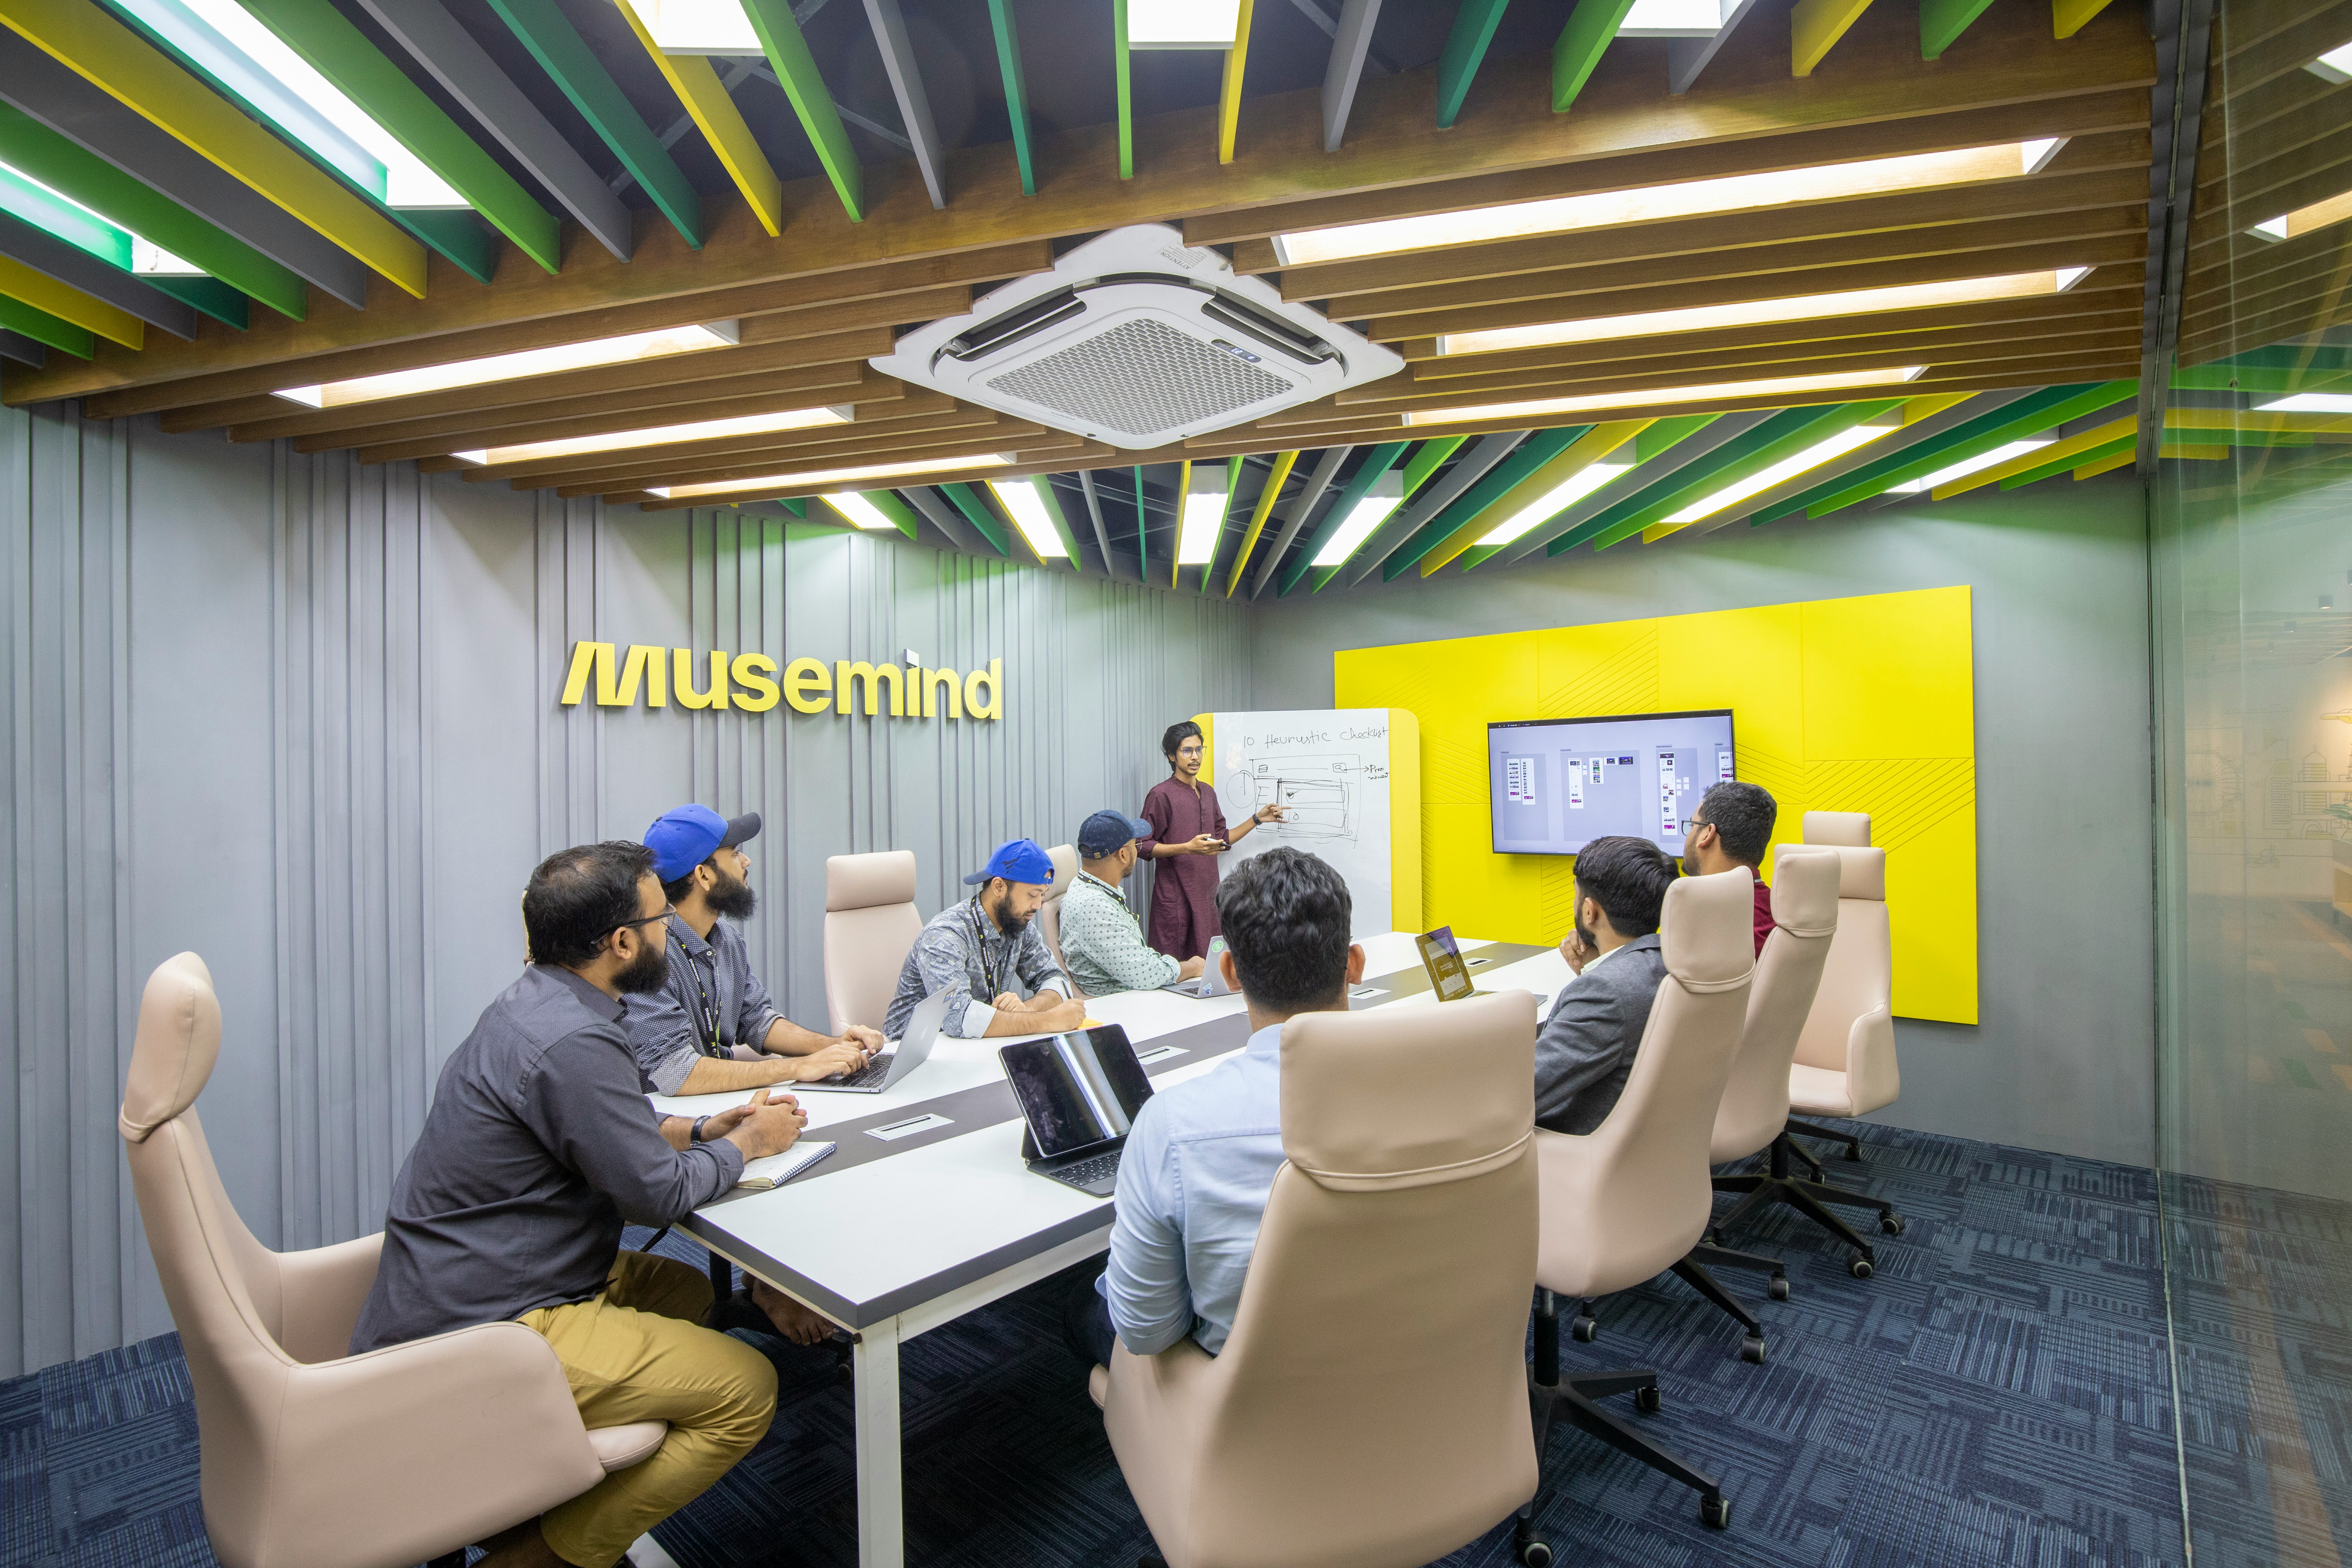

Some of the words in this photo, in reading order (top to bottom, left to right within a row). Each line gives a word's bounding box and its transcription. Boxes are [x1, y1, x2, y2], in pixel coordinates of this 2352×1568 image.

[561, 641, 1001, 720] Musemind
[1244, 736, 1254, 748] 10
[704, 1007, 713, 1032] Musemind
